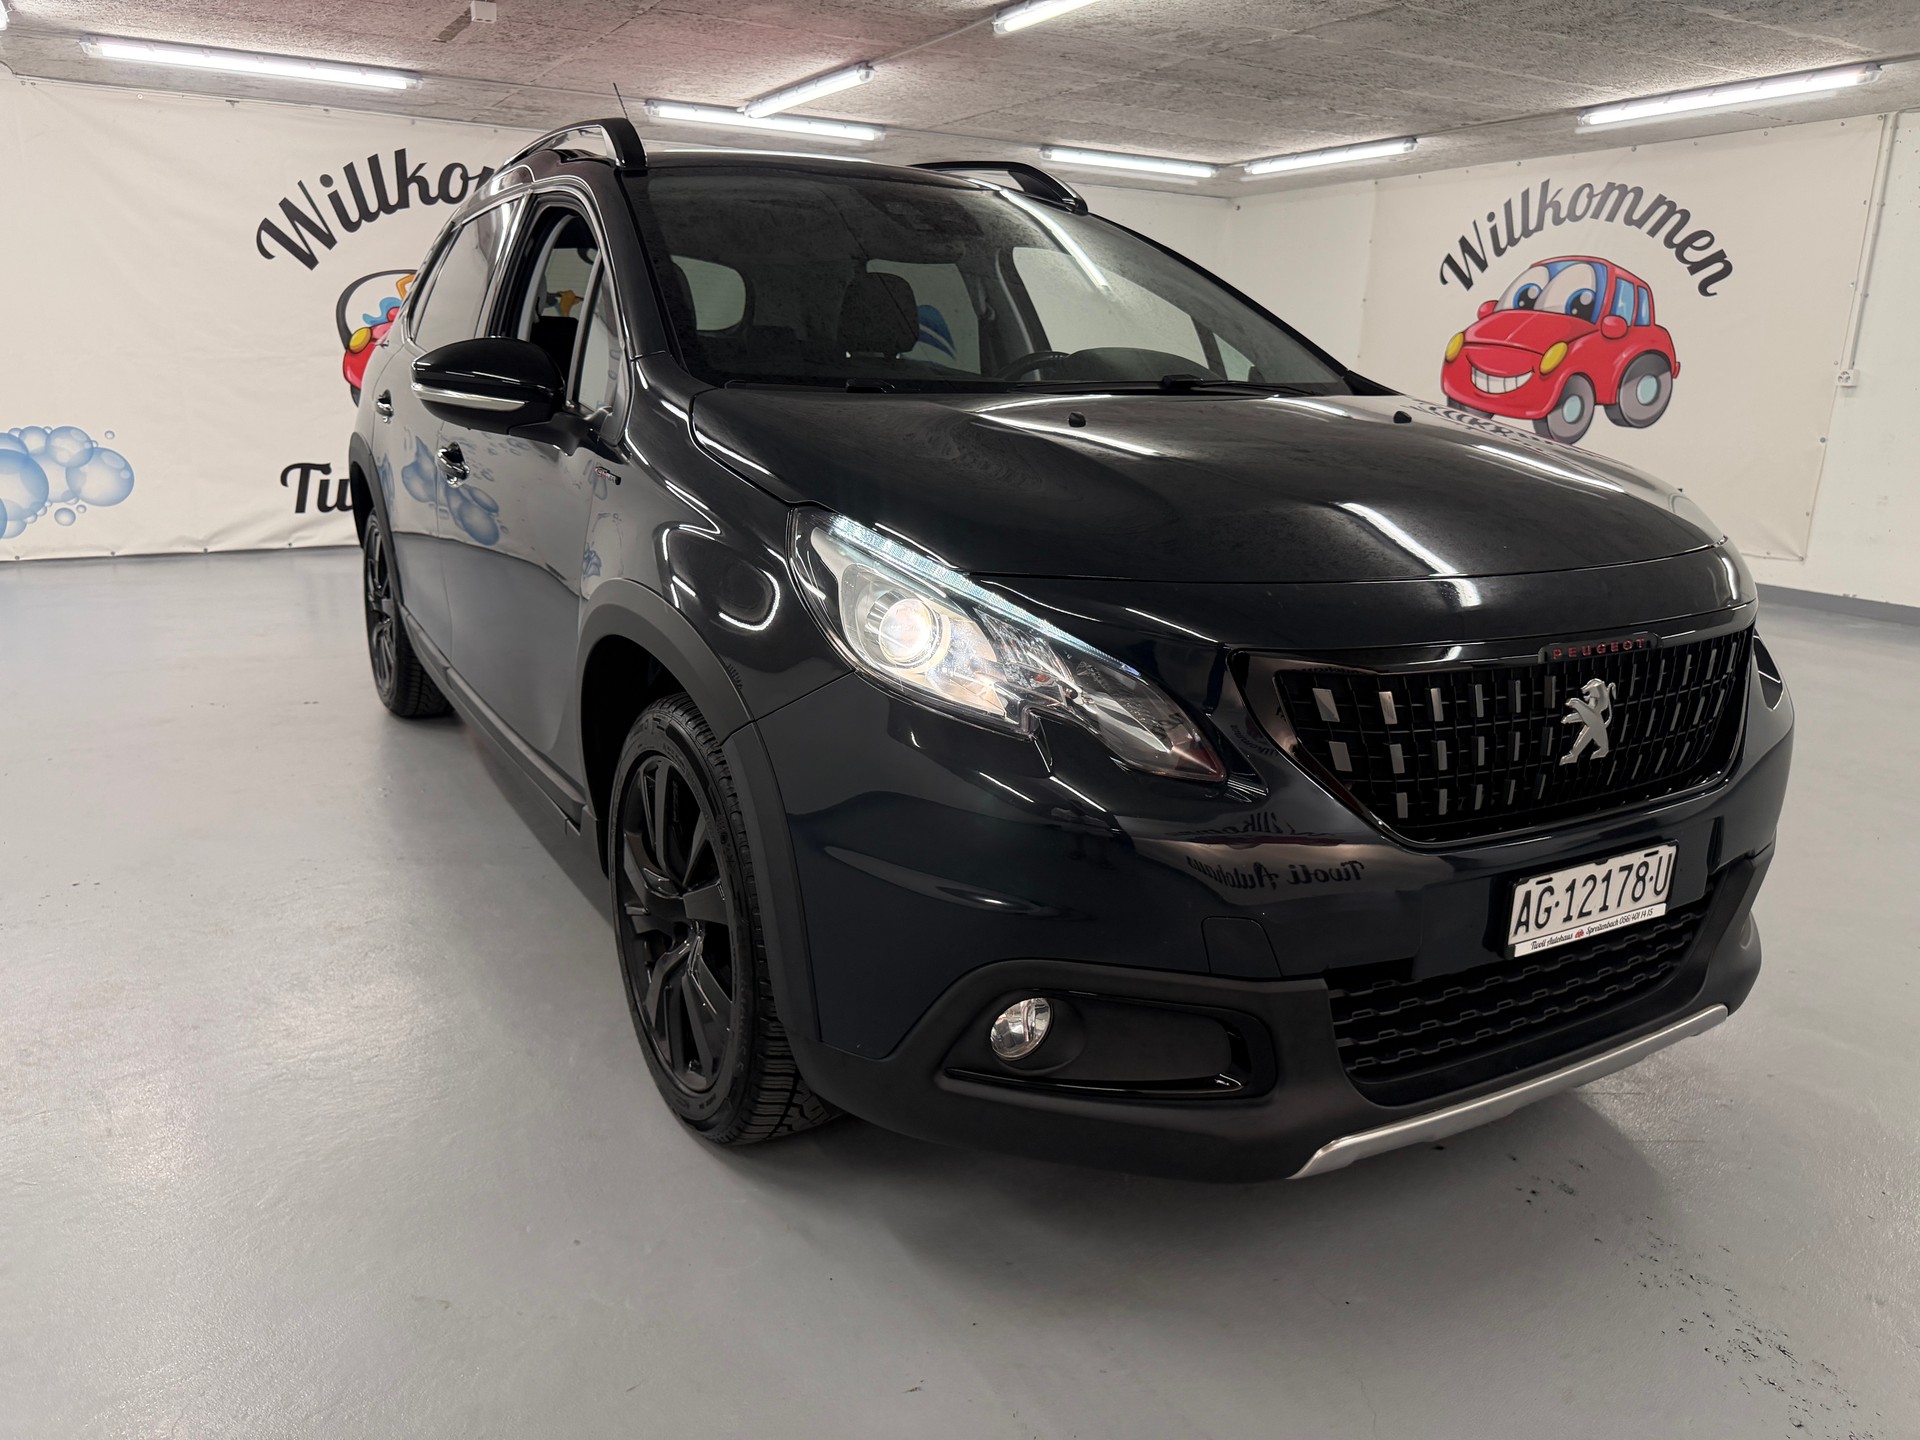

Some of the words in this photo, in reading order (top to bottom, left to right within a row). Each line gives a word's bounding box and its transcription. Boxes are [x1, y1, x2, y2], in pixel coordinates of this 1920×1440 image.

[1439, 178, 1734, 298] Willkommen
[1553, 638, 1645, 659] PEUGEOT
[1531, 939, 1546, 951] Tivoli
[1547, 933, 1574, 947] Autohaus
